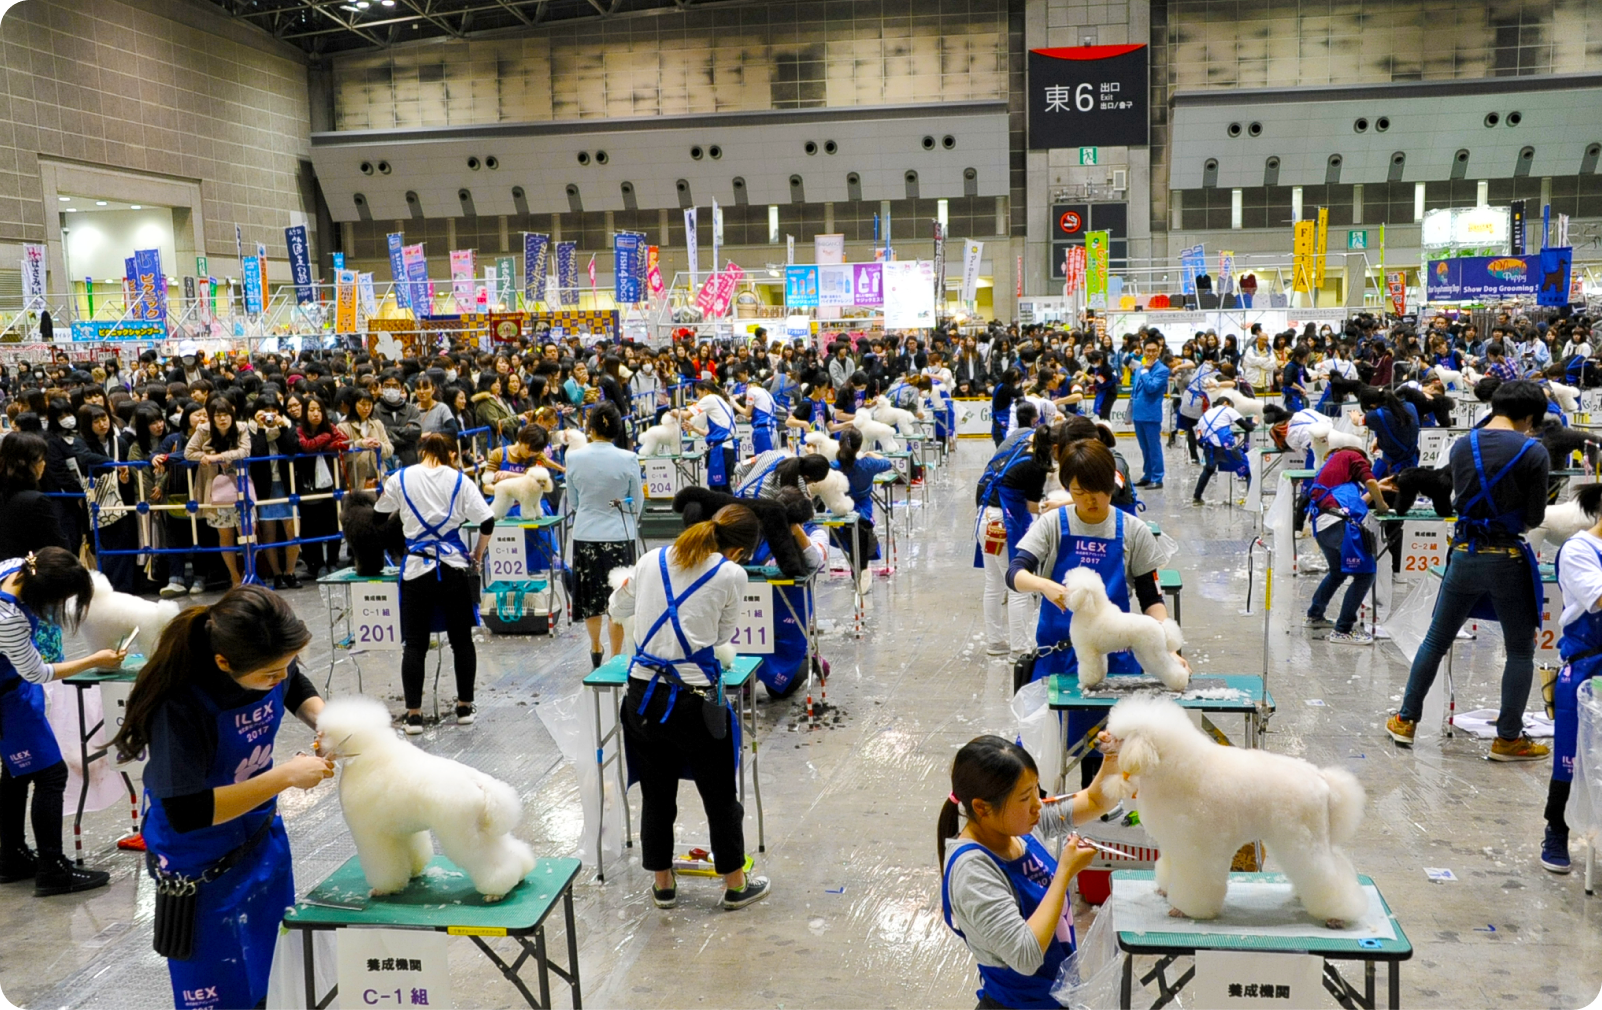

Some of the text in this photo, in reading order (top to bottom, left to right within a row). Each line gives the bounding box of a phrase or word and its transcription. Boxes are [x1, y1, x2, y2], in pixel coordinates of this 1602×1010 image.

[1100, 82, 1120, 92] 出口
[618, 251, 628, 302] FISH4DOGS
[1483, 286, 1498, 294] Dog
[1498, 284, 1534, 293] Grooming
[509, 464, 525, 473] ILEX
[650, 482, 671, 493] 204
[1076, 540, 1107, 553] ILEX
[493, 560, 523, 575] 202
[359, 624, 395, 643] 201
[730, 626, 766, 645] 211
[235, 700, 274, 728] ILEX
[246, 725, 269, 743] 2017
[9, 749, 31, 761] ILEX
[367, 958, 422, 972] 養成機関
[182, 986, 218, 1001] ILEX
[363, 987, 429, 1006] C-1 組
[1228, 983, 1290, 999] 養成機関
